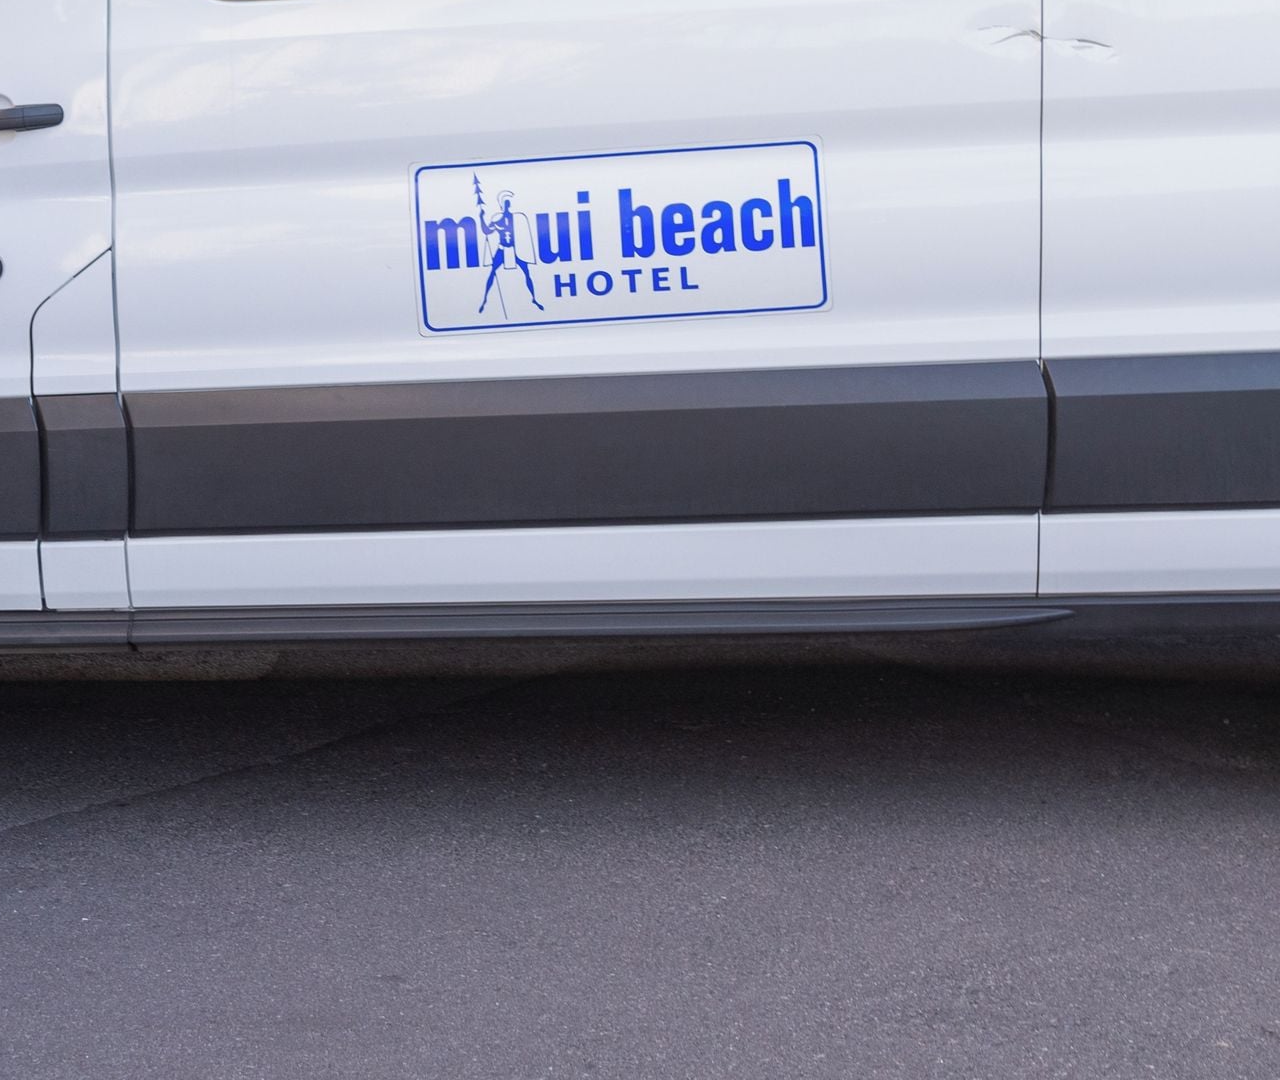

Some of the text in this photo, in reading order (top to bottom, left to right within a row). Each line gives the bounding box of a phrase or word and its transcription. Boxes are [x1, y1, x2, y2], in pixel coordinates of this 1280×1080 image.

[424, 177, 817, 272] mui beach
[553, 265, 699, 298] HOTEL
